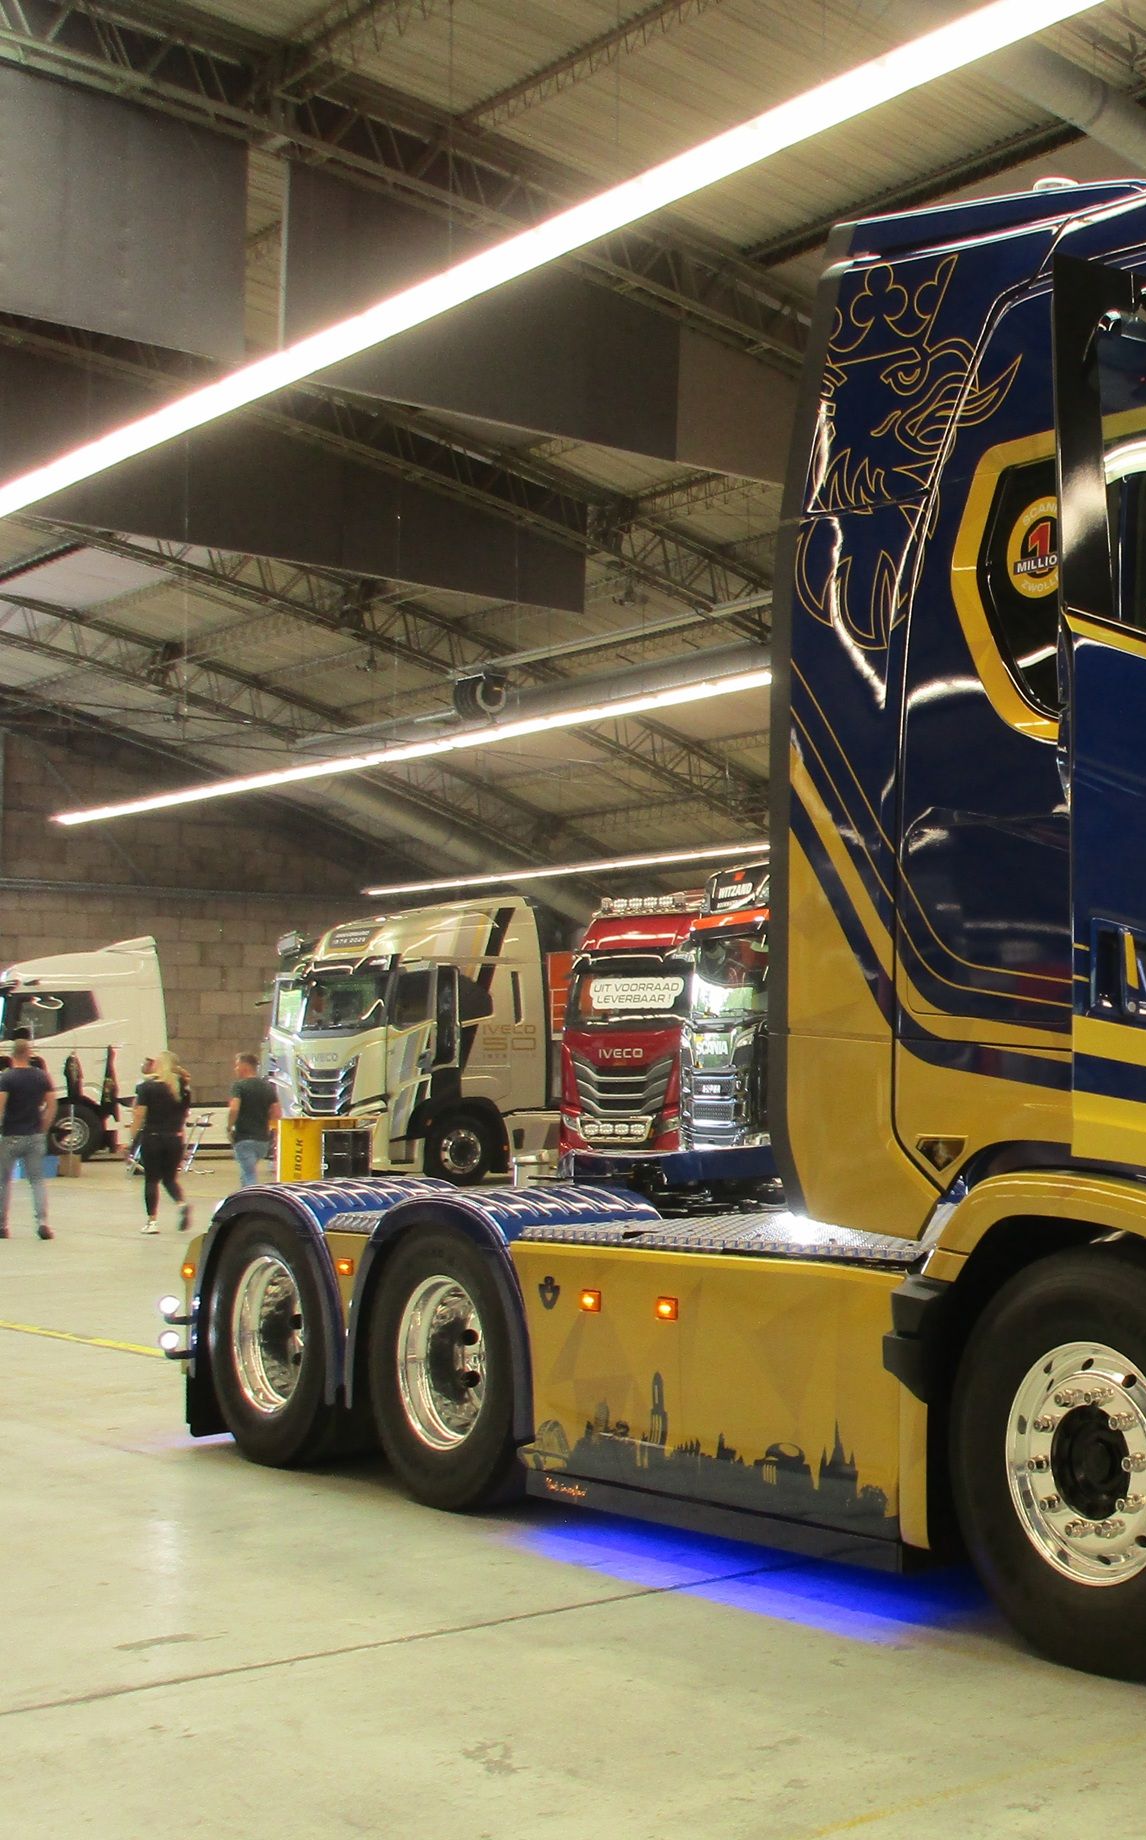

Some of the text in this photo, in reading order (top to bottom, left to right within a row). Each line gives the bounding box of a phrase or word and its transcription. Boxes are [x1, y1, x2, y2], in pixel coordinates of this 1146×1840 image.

[1028, 521, 1051, 574] 1
[1016, 555, 1058, 574] MILLIO
[1021, 572, 1059, 593] ZWOLL
[593, 982, 680, 993] UIT VOORRAAD
[596, 993, 665, 1004] LEVERBAAR
[598, 1047, 644, 1060] IVECO
